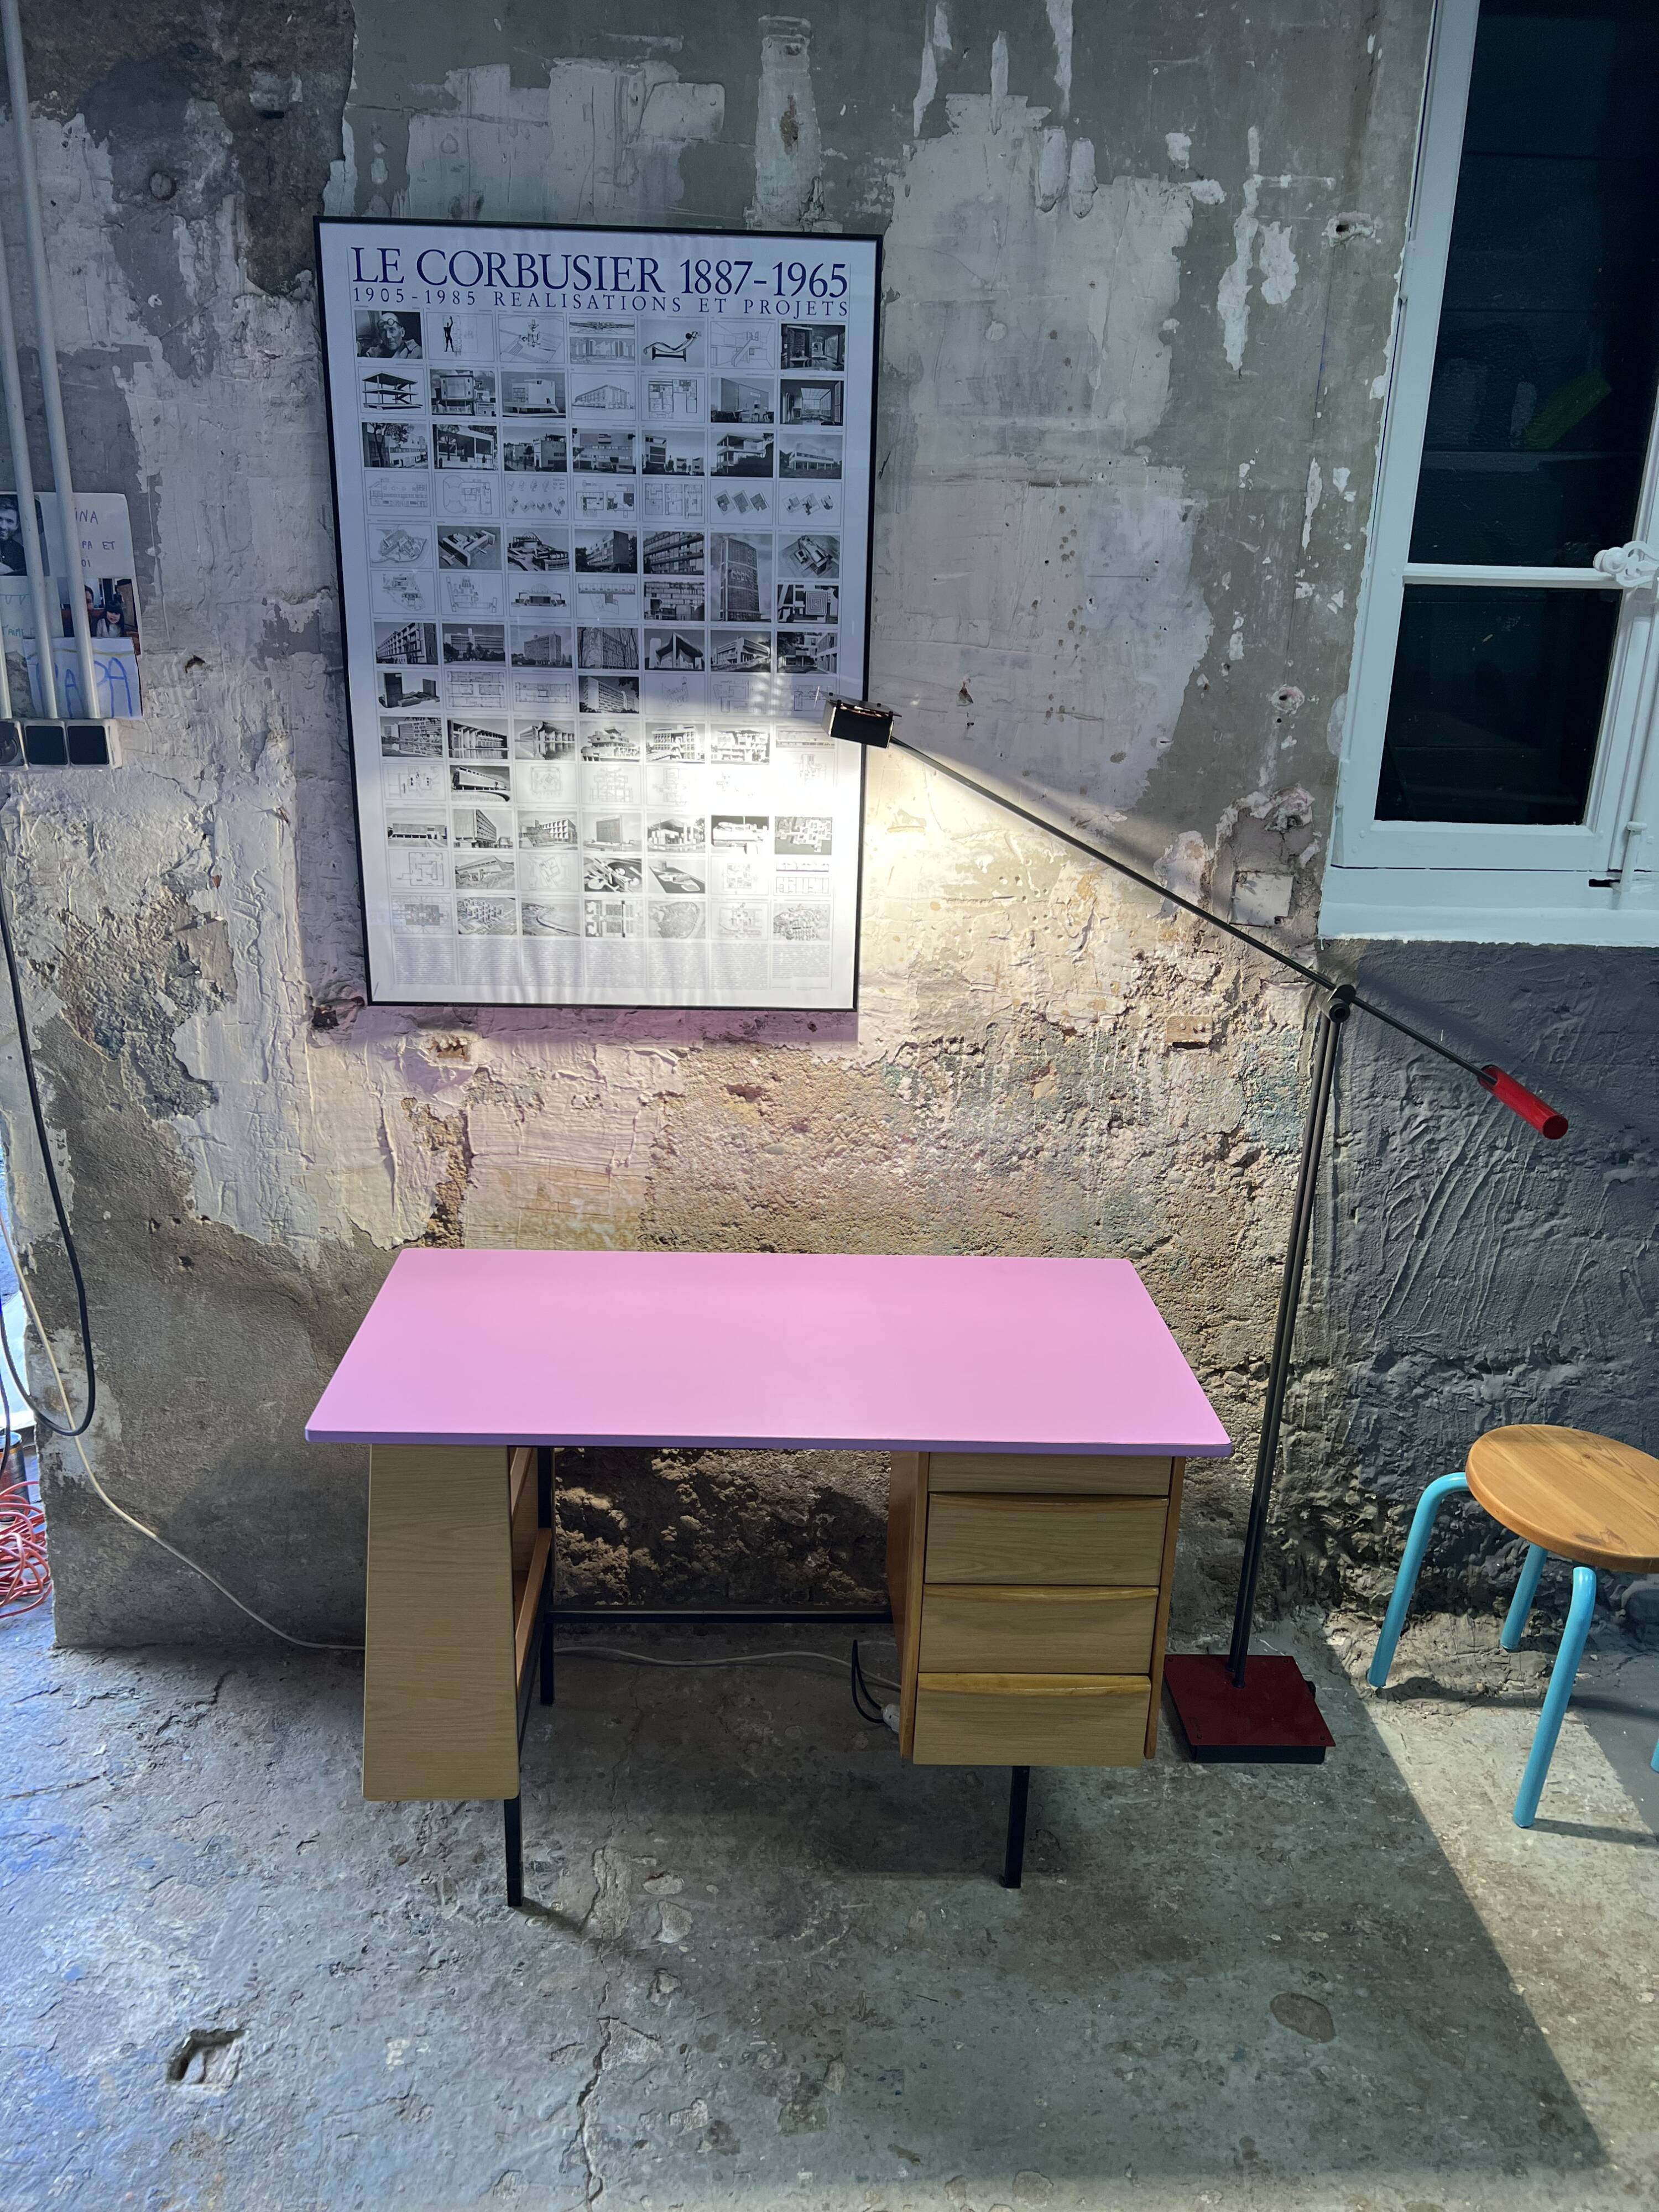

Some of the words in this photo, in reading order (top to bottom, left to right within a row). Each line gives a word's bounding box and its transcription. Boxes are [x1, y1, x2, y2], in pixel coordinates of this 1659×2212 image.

[351, 247, 404, 284] LE
[416, 249, 665, 293] CORBUSIER
[680, 259, 848, 298] 1887-1965
[353, 288, 476, 305] 1905-1985
[494, 291, 681, 312] REALISATIONS
[700, 298, 727, 313] ET
[744, 300, 848, 319] PROJETS
[102, 541, 115, 550] ET
